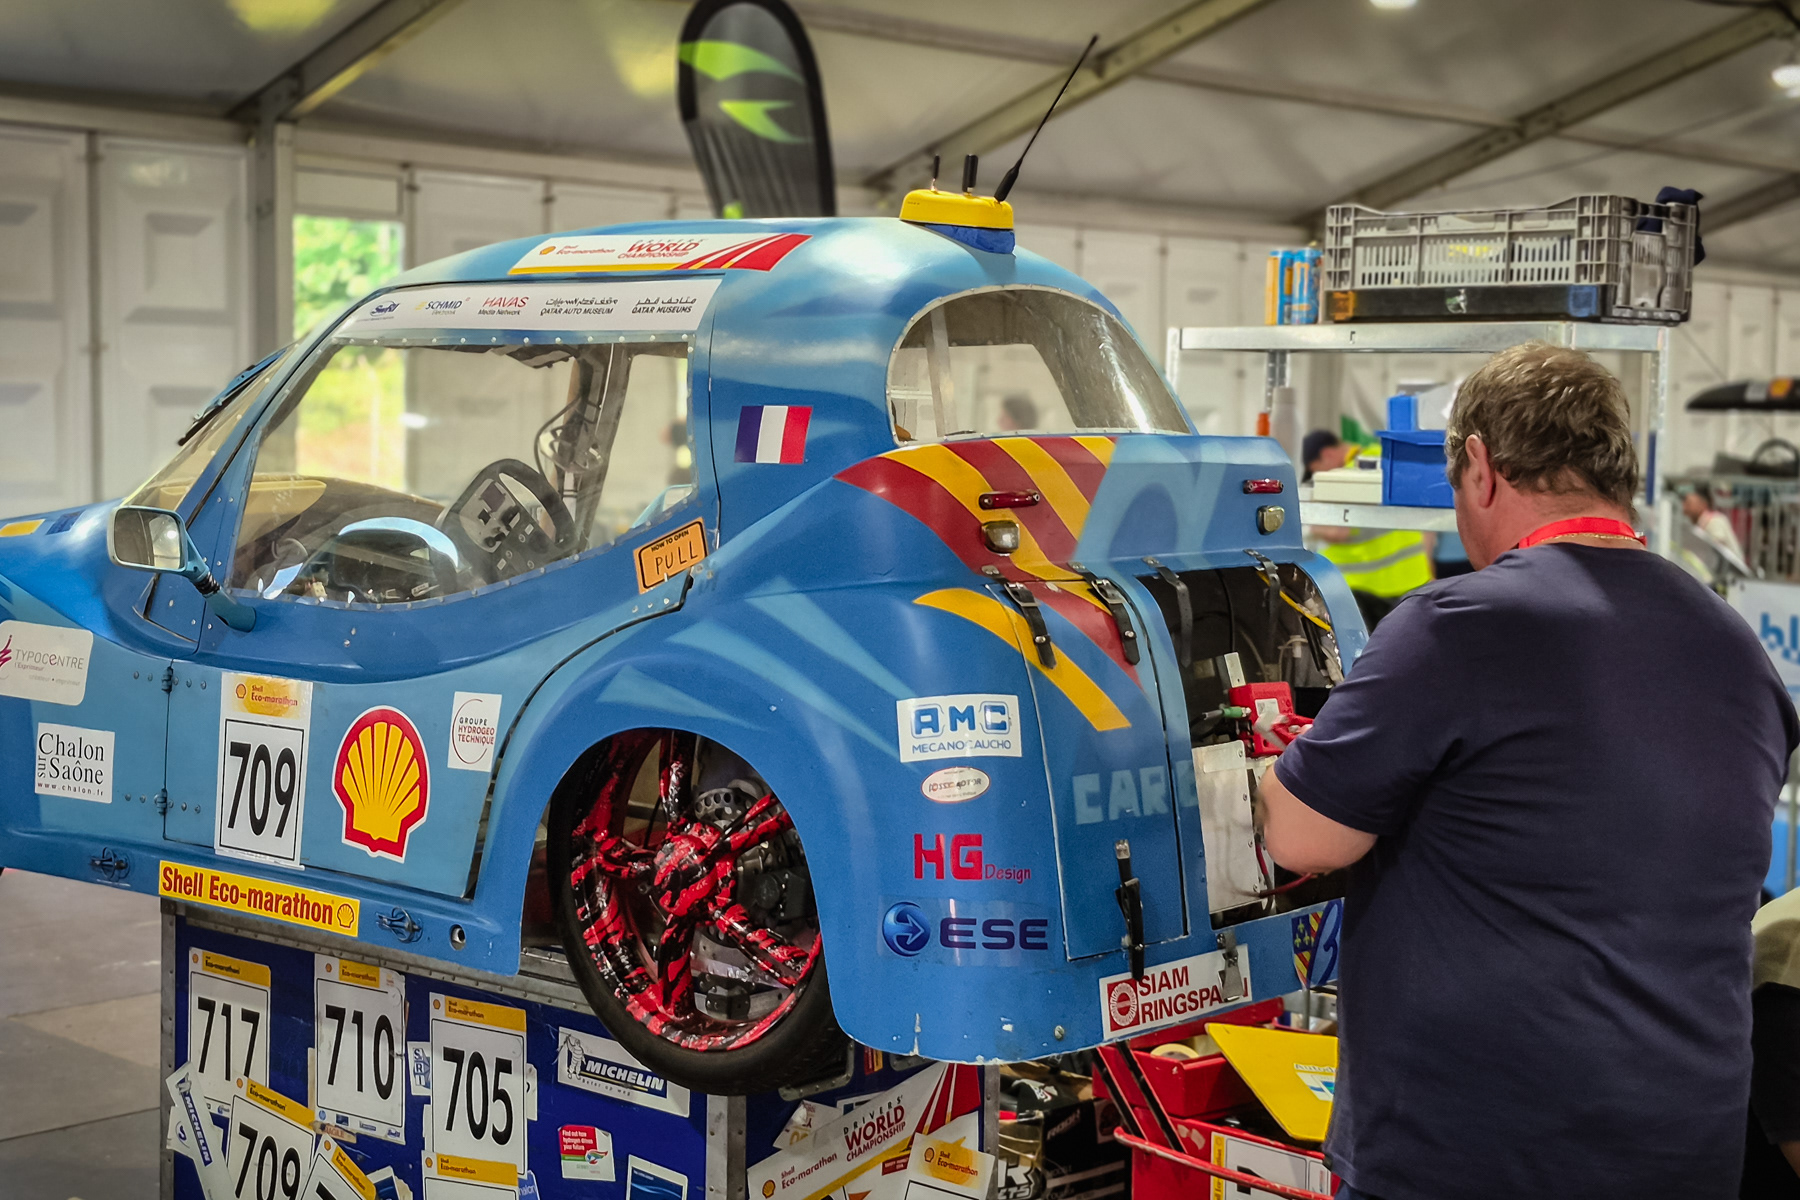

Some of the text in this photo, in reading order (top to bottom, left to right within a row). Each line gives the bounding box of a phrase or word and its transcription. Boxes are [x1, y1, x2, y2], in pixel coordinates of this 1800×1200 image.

[627, 242, 700, 252] WORLD
[426, 301, 463, 310] SCHMID
[482, 296, 530, 308] HAVAS
[540, 307, 614, 316] QATAR AUTO MUSEUM
[656, 306, 692, 314] MUSEUMS
[651, 542, 665, 552] HOW
[674, 530, 689, 541] OPEN
[655, 541, 698, 575] PULL
[251, 685, 264, 693] Shell
[251, 692, 298, 706] Eco-marathon
[458, 725, 495, 736] HYDROGEO
[459, 717, 488, 726] GROUPE
[914, 704, 1008, 735] AMC
[38, 732, 104, 762] Chalon
[458, 734, 494, 746] TECHNIQUE
[912, 739, 1012, 754] MECANOCAUCHO
[38, 755, 47, 778] sur
[49, 757, 104, 785] Saône
[37, 782, 104, 796] www.chalon.fr
[227, 741, 296, 838] 709
[914, 833, 1031, 884] HG Design
[162, 866, 333, 925] Shell Eco-marathon
[939, 917, 1049, 950] ESE
[1138, 966, 1190, 996] SIAM
[197, 996, 260, 1082] 717
[325, 1004, 395, 1101] 710
[586, 1060, 664, 1091] MICHELIN
[443, 1046, 513, 1146] 705
[185, 1096, 212, 1162] MICHELIN
[844, 1105, 905, 1150] WORLD
[846, 1121, 907, 1162] CHAMPIONSHIP
[235, 1121, 301, 1200] 709
[937, 1158, 979, 1176] Eco-marathon
[939, 1151, 951, 1159] Shell
[781, 1152, 838, 1190] Eco-marathon
[781, 1166, 795, 1179] Shell
